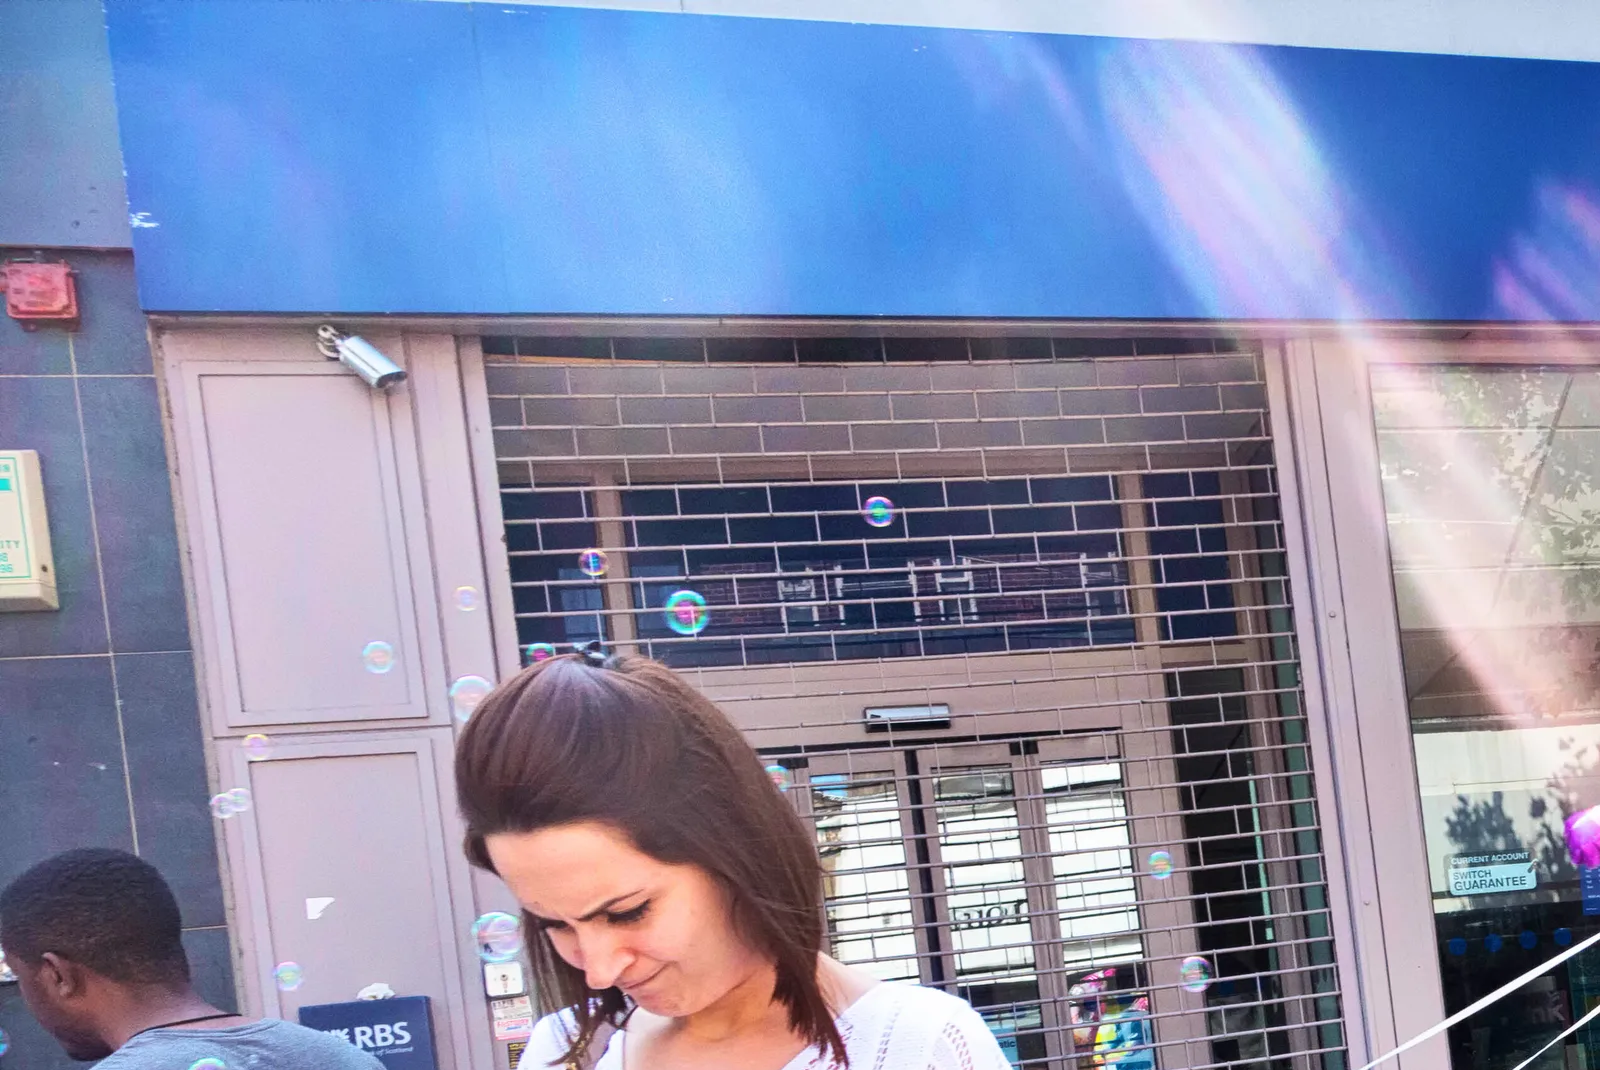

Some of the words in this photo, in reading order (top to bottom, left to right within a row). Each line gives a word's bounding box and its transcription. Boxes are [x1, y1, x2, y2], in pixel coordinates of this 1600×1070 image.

[1450, 854, 1489, 865] CURRENT
[1491, 852, 1530, 862] ACCOUNT
[1453, 869, 1492, 881] SWITCH
[1454, 876, 1527, 891] GUARANTEE
[354, 1021, 412, 1048] RBS
